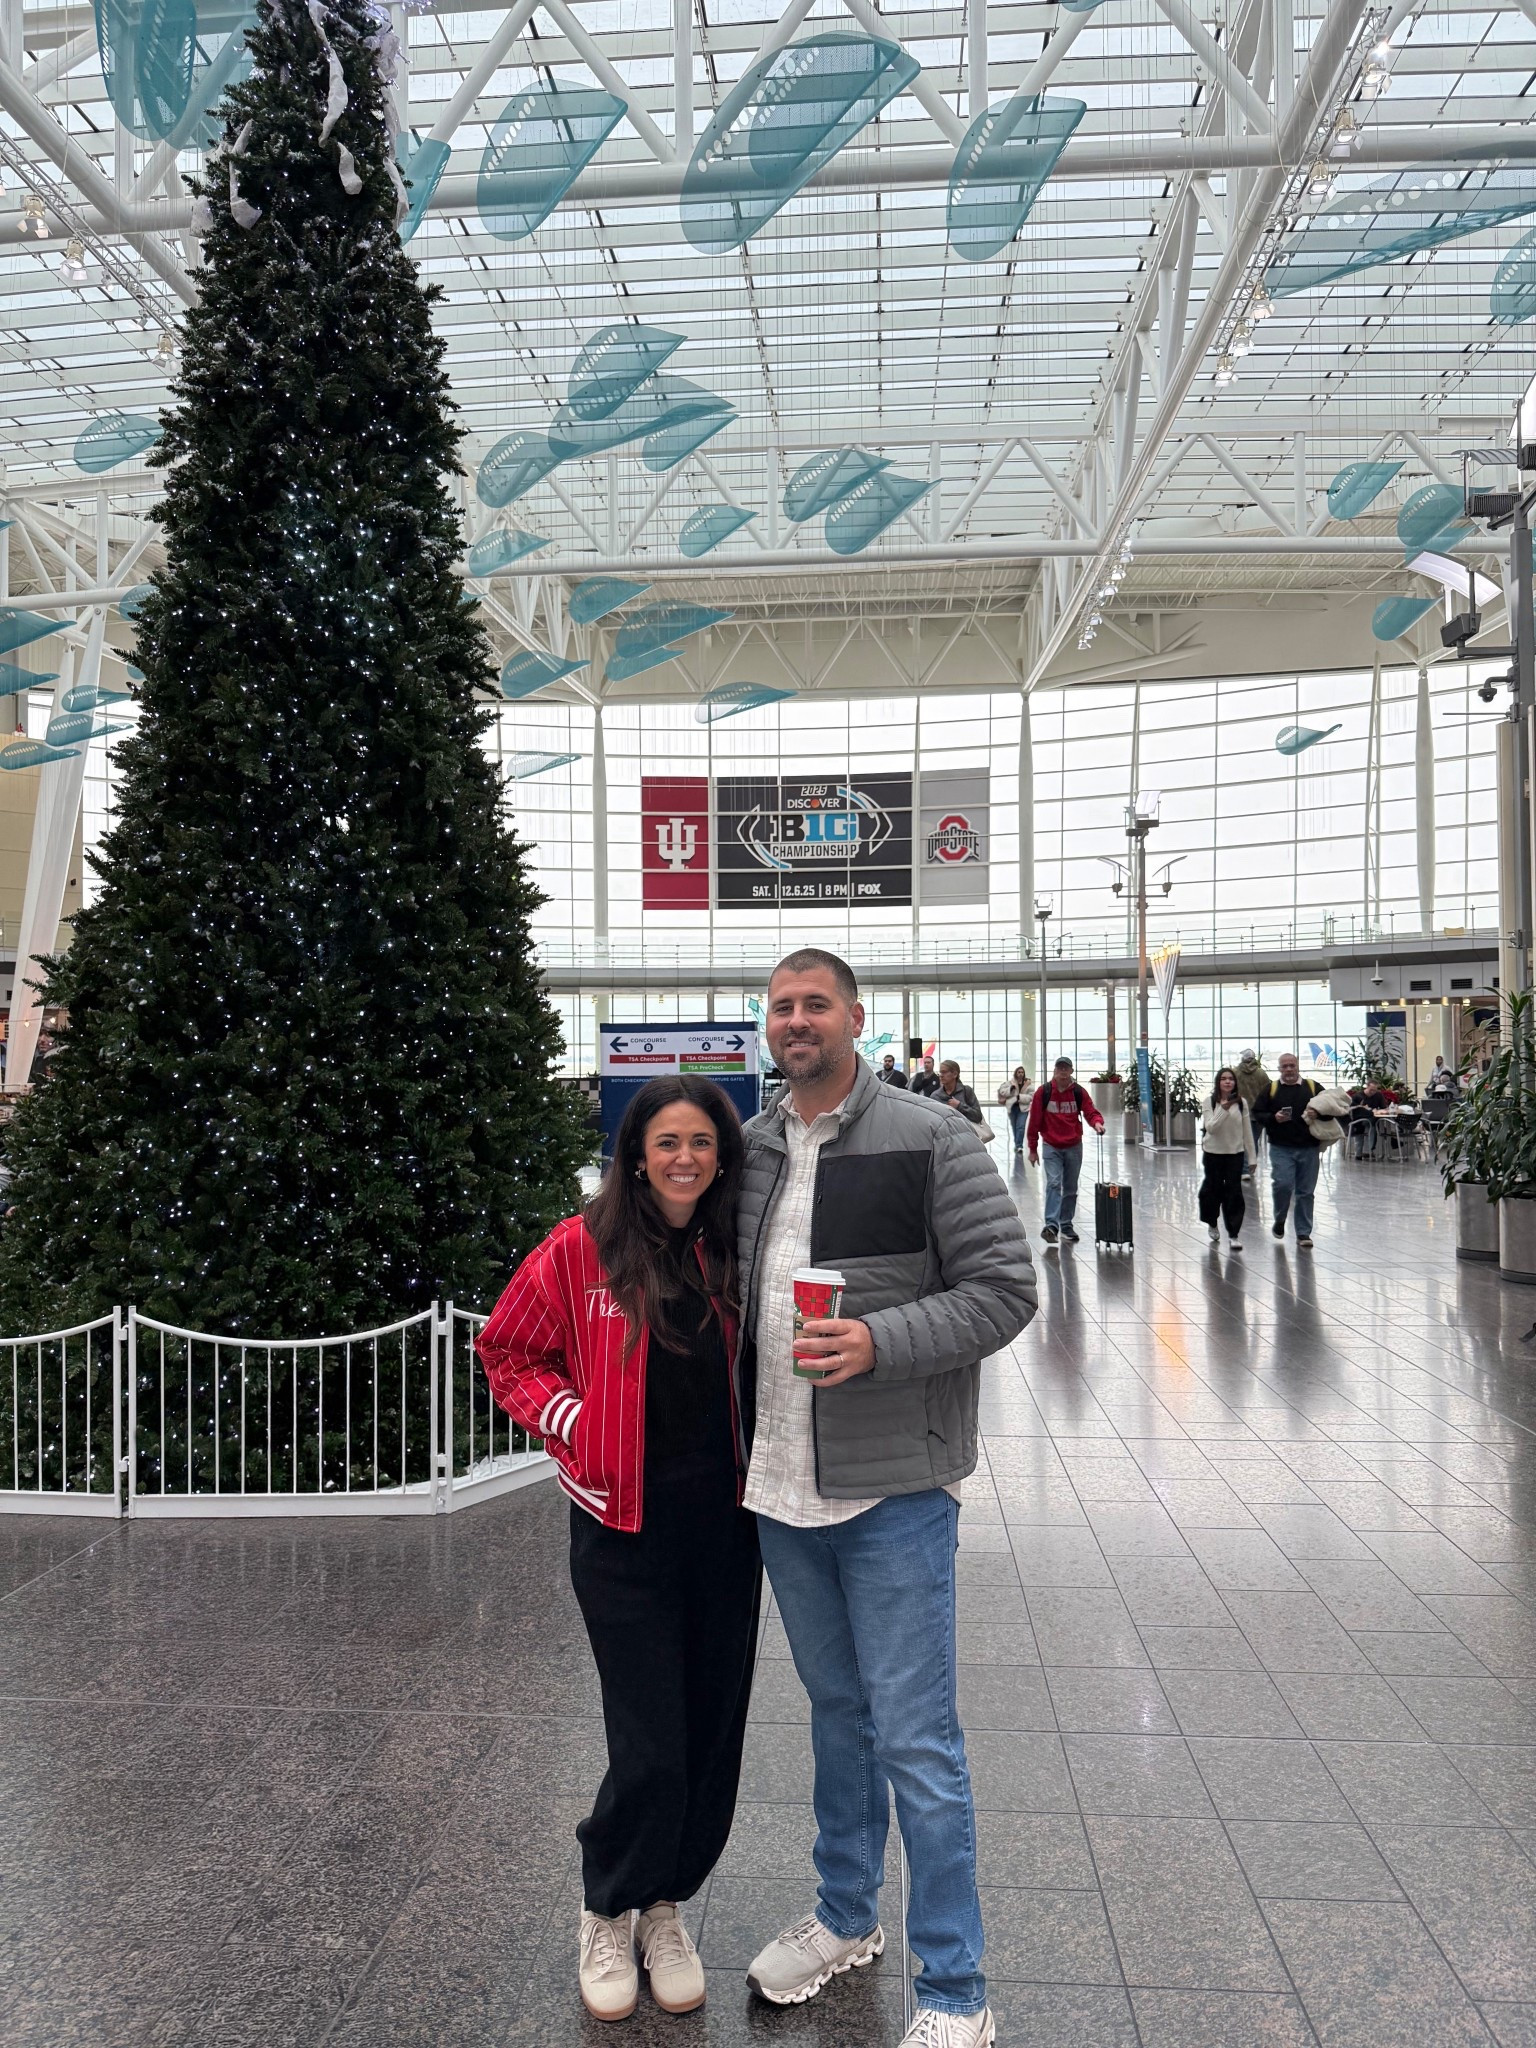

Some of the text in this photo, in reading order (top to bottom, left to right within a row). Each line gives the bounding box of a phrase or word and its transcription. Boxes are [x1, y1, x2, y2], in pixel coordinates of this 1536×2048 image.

[802, 786, 827, 795] 2025
[787, 798, 840, 809] DISCOVER
[772, 844, 857, 858] CHAMPIONSHIP
[752, 883, 881, 897] SAT. 12.6.25 8 PM FOX
